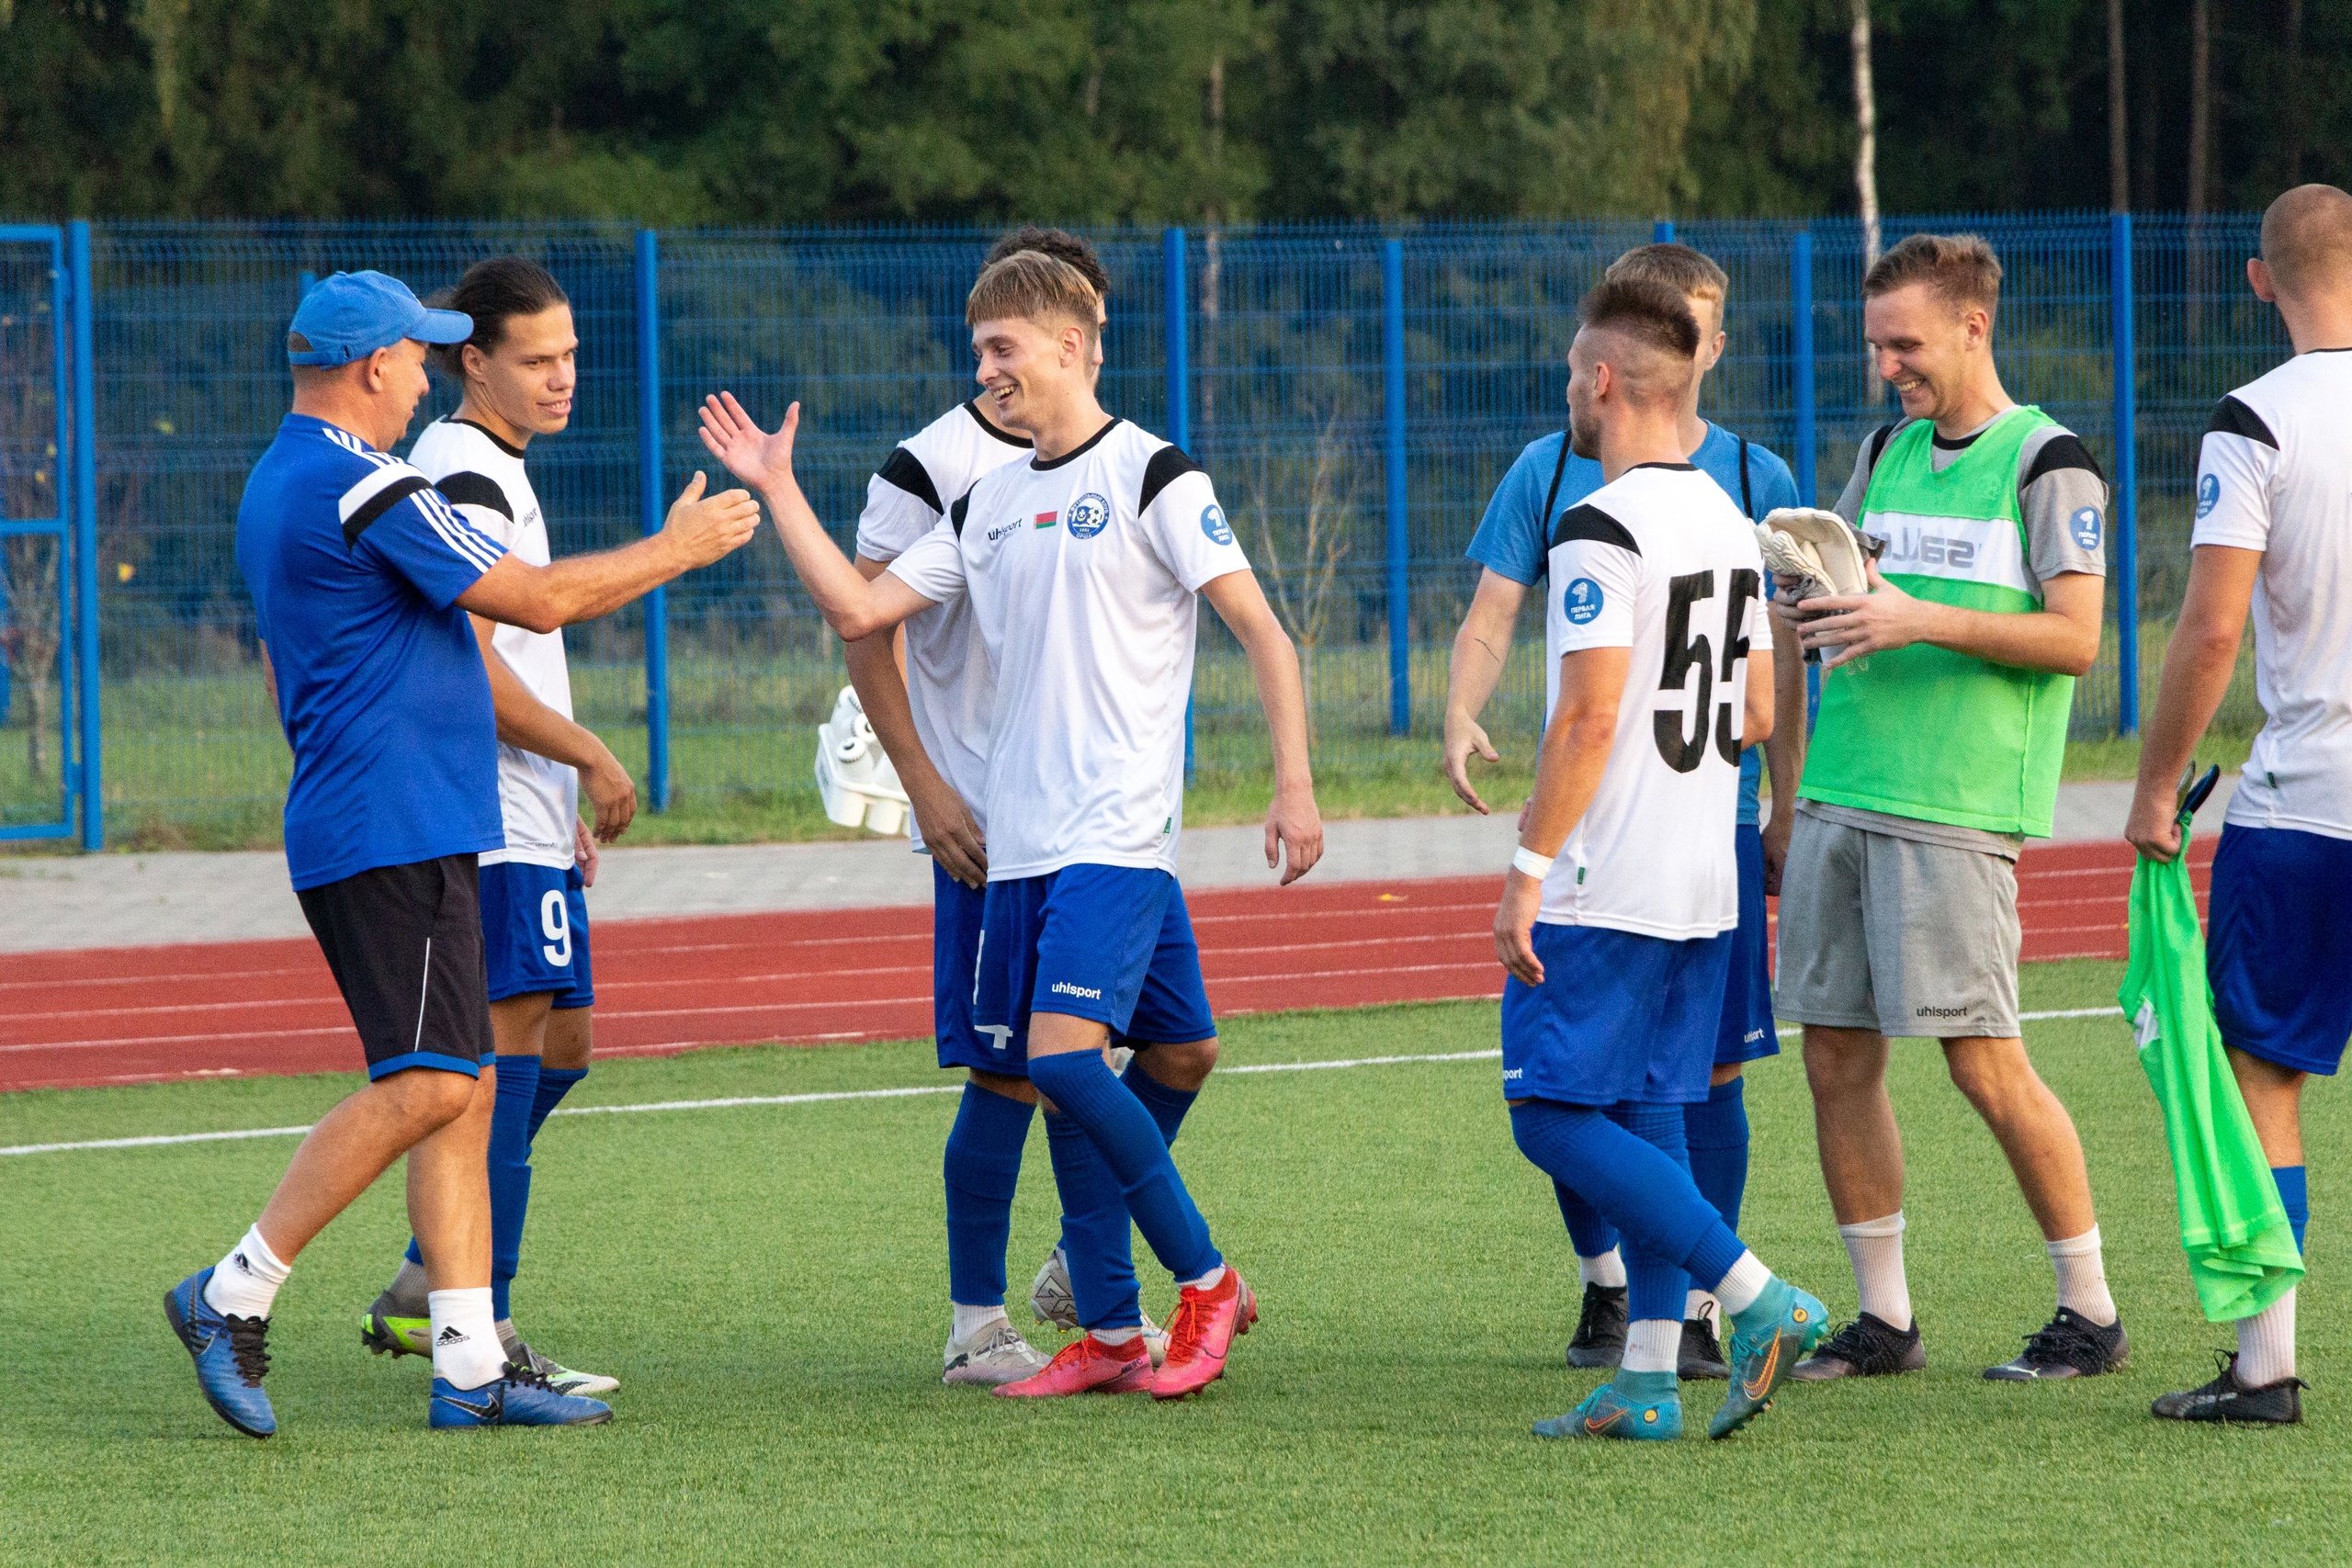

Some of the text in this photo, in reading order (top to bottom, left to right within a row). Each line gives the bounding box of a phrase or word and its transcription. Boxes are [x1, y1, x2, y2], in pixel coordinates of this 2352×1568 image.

[1570, 604, 1596, 614] ПЕРВАЯ
[1574, 612, 1591, 620] ЛИГА
[1654, 569, 1760, 773] 55
[541, 889, 571, 966] 9
[1051, 981, 1102, 1000] uhlsport
[1916, 1005, 1968, 1019] uhlsport
[436, 1335, 470, 1347] adidas
